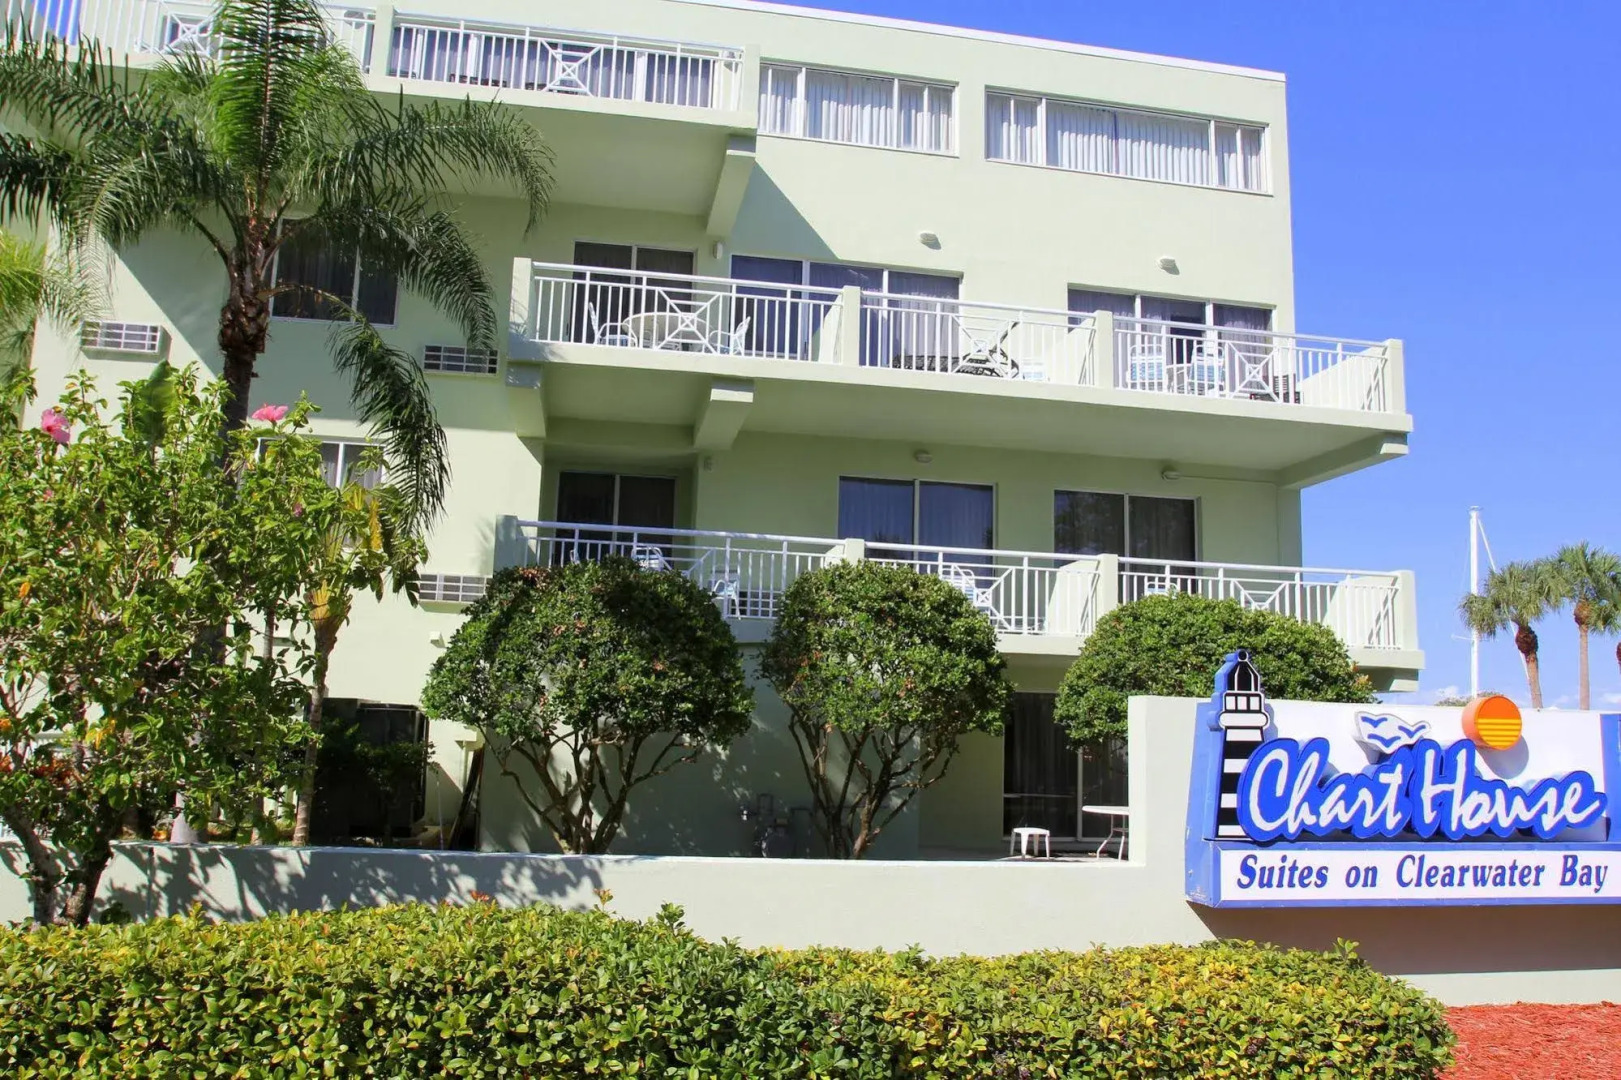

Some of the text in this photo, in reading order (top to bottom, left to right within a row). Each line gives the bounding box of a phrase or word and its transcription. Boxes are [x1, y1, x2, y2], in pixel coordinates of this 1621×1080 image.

[1249, 747, 1601, 833] Chart House
[1236, 854, 1608, 893] Suites on Clearwater Bay
